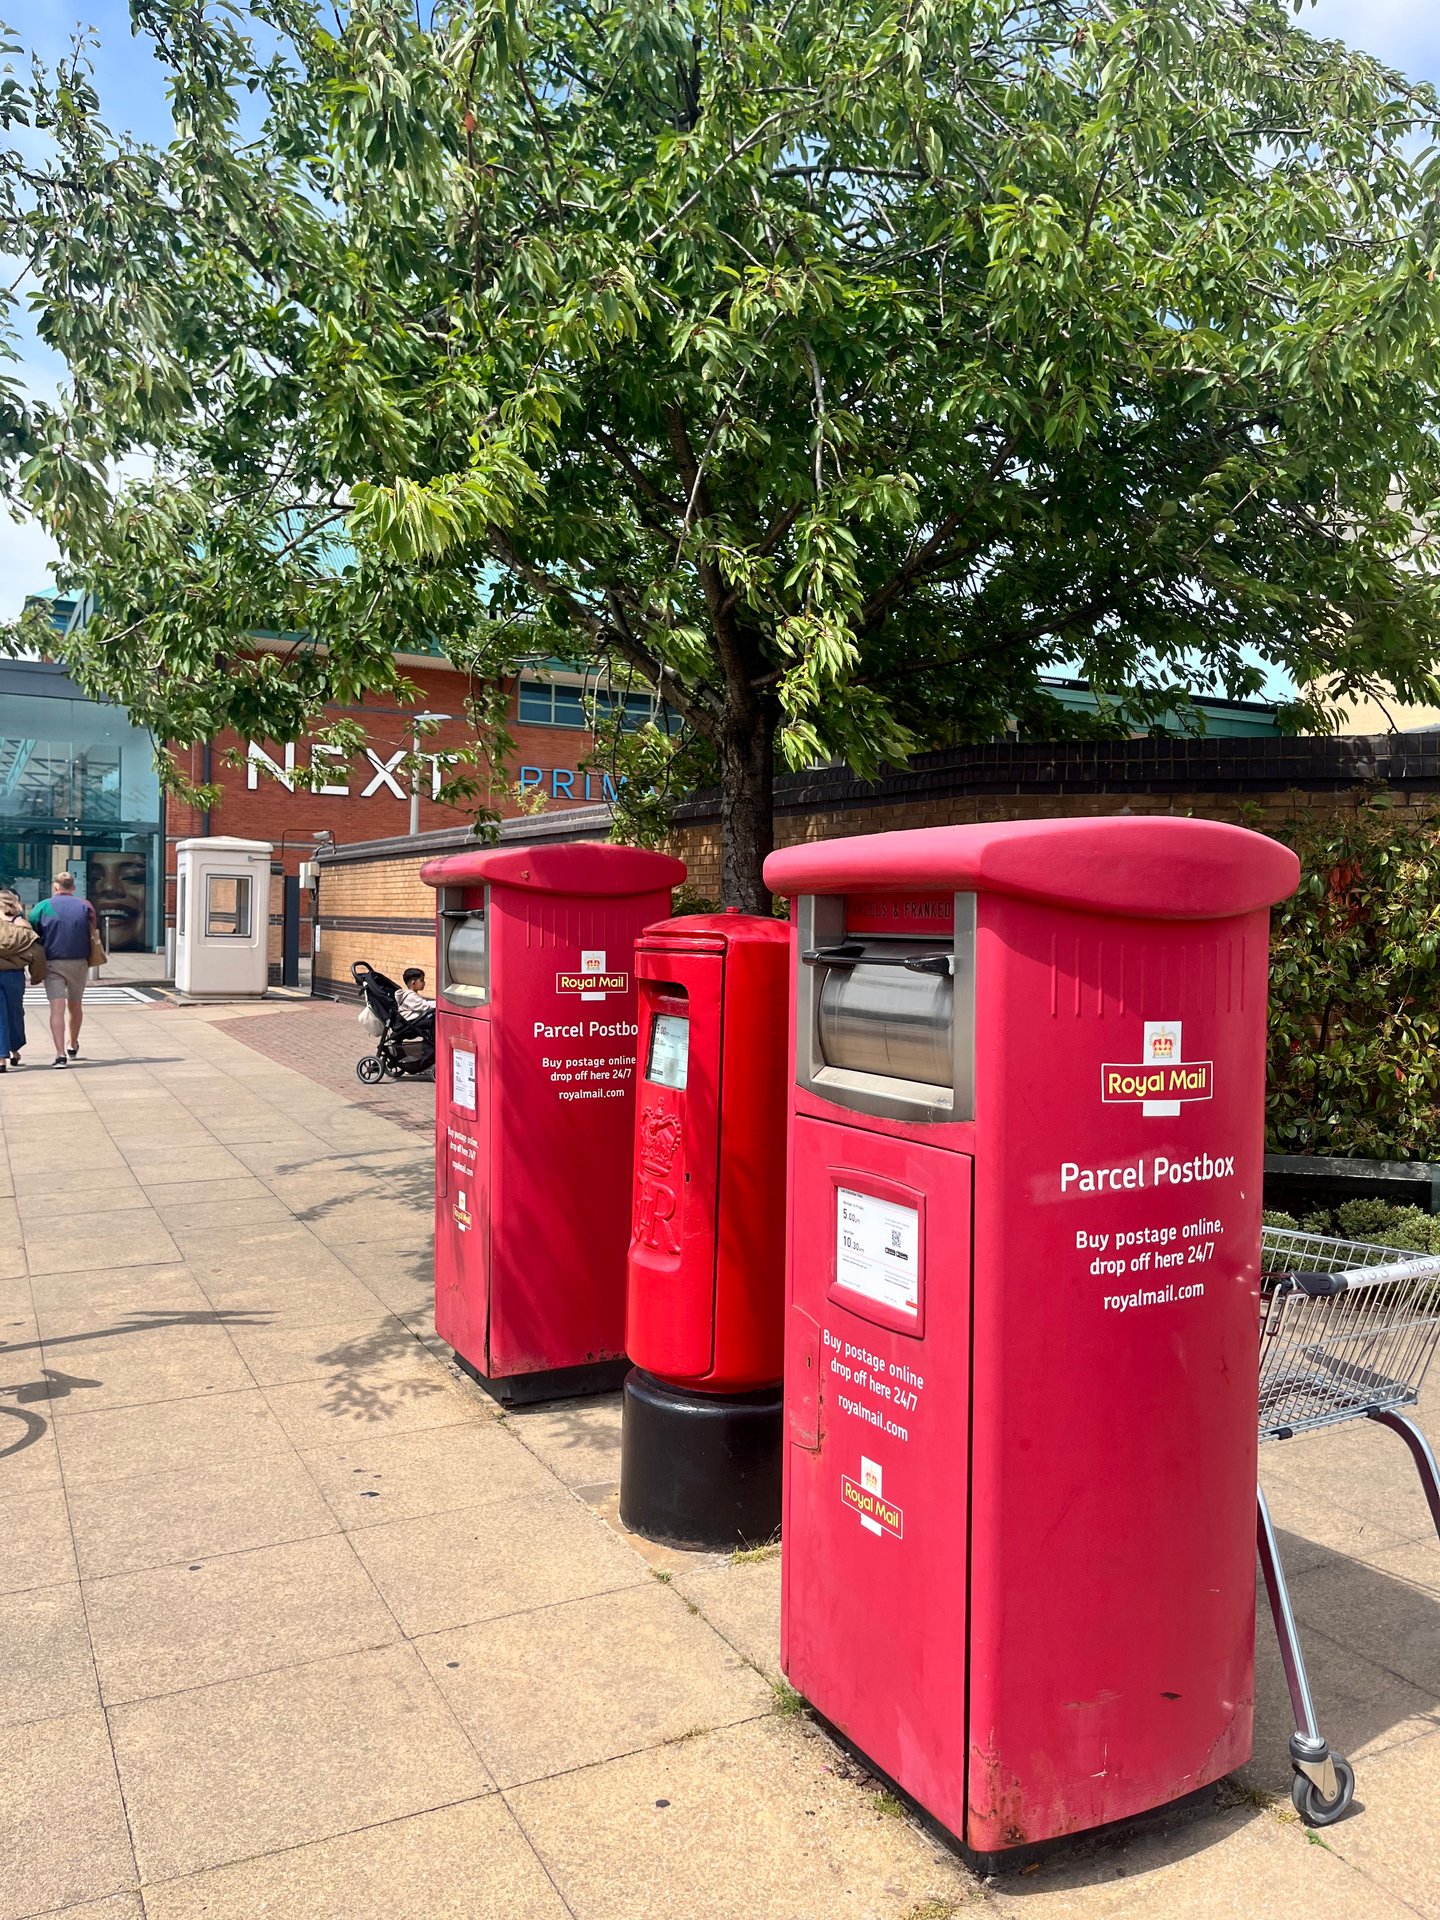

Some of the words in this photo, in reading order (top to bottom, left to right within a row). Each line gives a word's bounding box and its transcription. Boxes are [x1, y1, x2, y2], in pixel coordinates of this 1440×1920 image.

[247, 739, 459, 801] NEXT
[892, 902, 899, 918] &
[904, 902, 951, 918] FRANKED
[561, 976, 596, 990] Royal
[598, 976, 624, 988] Mail
[533, 1021, 584, 1038] Parcel
[589, 1020, 639, 1038] Postbo
[542, 1057, 562, 1069] Buy
[565, 1056, 605, 1069] postage
[550, 1071, 572, 1083] drop
[574, 1070, 588, 1081] off
[590, 1069, 610, 1080] here
[612, 1068, 632, 1079] 24/7
[558, 1088, 625, 1101] royalmail.com
[1108, 1071, 1164, 1097] Royal
[1169, 1068, 1206, 1091] Mail
[1060, 1160, 1144, 1192] Parcel
[1154, 1153, 1235, 1187] Postbox
[1075, 1230, 1109, 1251] Buy
[1115, 1227, 1177, 1250] postage
[1182, 1217, 1224, 1238] online,
[1089, 1257, 1126, 1277] drop
[1130, 1252, 1150, 1272] off
[1154, 1250, 1184, 1270] here
[1187, 1242, 1215, 1263] 24/7
[1103, 1281, 1205, 1313] royalmail.com
[823, 1328, 842, 1352] Buy
[845, 1341, 885, 1372] postage
[889, 1363, 924, 1390] online
[830, 1357, 851, 1382] drop
[853, 1369, 867, 1388] off
[869, 1377, 891, 1399] here
[893, 1386, 918, 1412] 24/7
[837, 1394, 908, 1442] royalmail.com
[845, 1481, 874, 1513] Royal
[875, 1500, 899, 1529] Mail
